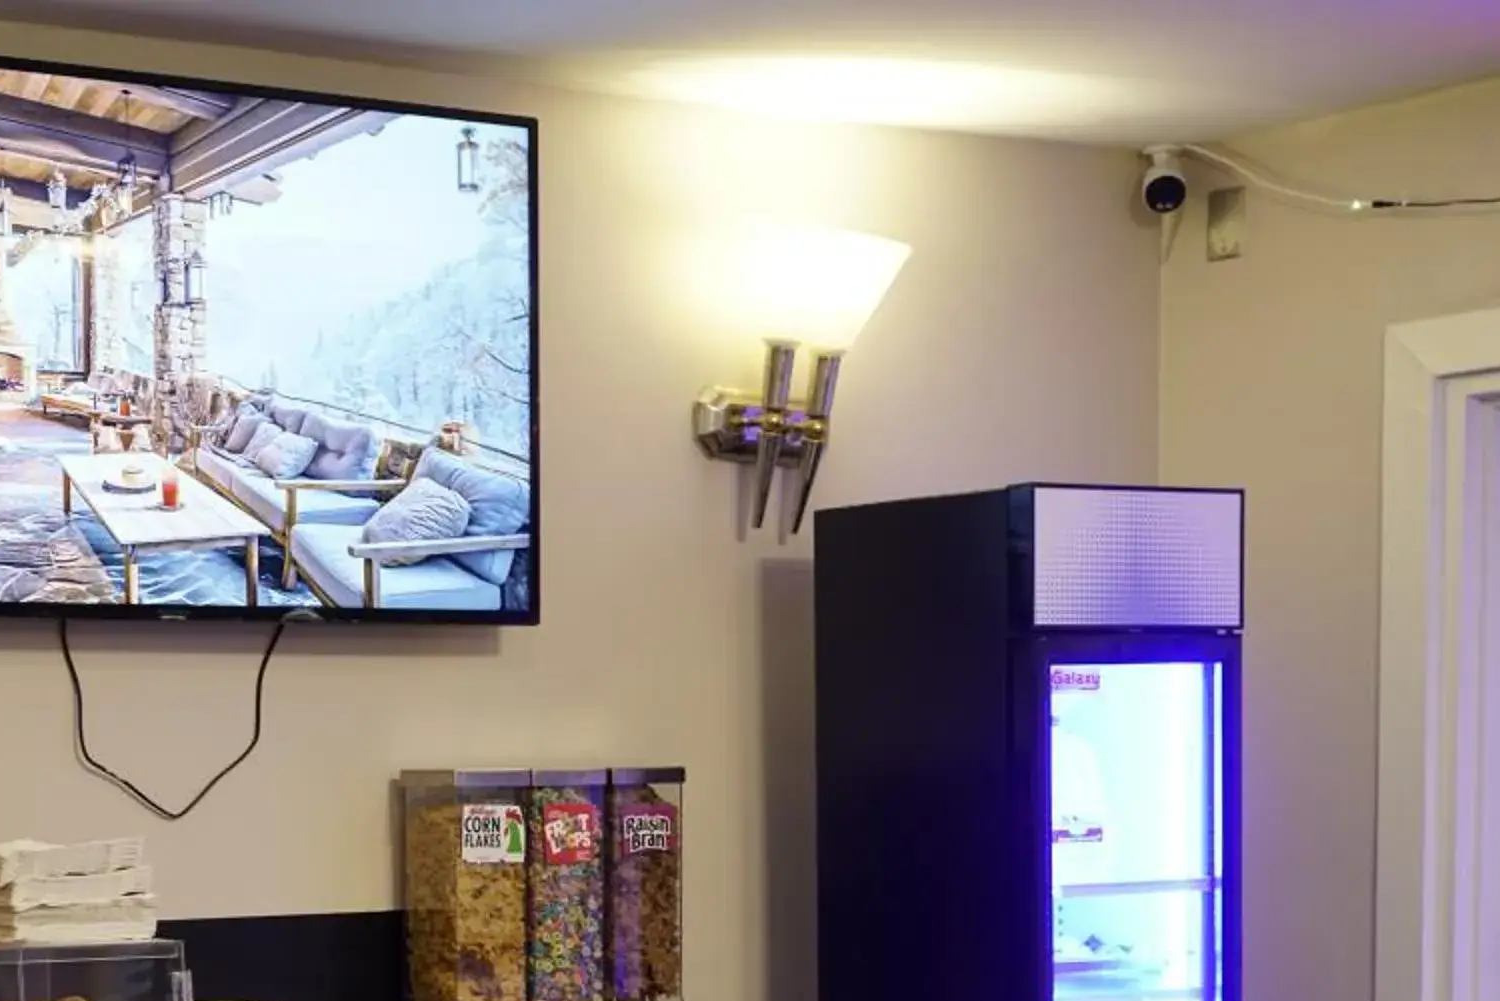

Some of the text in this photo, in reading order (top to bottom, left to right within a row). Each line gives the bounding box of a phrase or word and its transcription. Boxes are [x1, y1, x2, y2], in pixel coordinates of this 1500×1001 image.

[465, 815, 501, 833] CORN
[623, 815, 671, 838] Raisin
[464, 833, 501, 849] FLAKES
[629, 832, 667, 853] Bran
